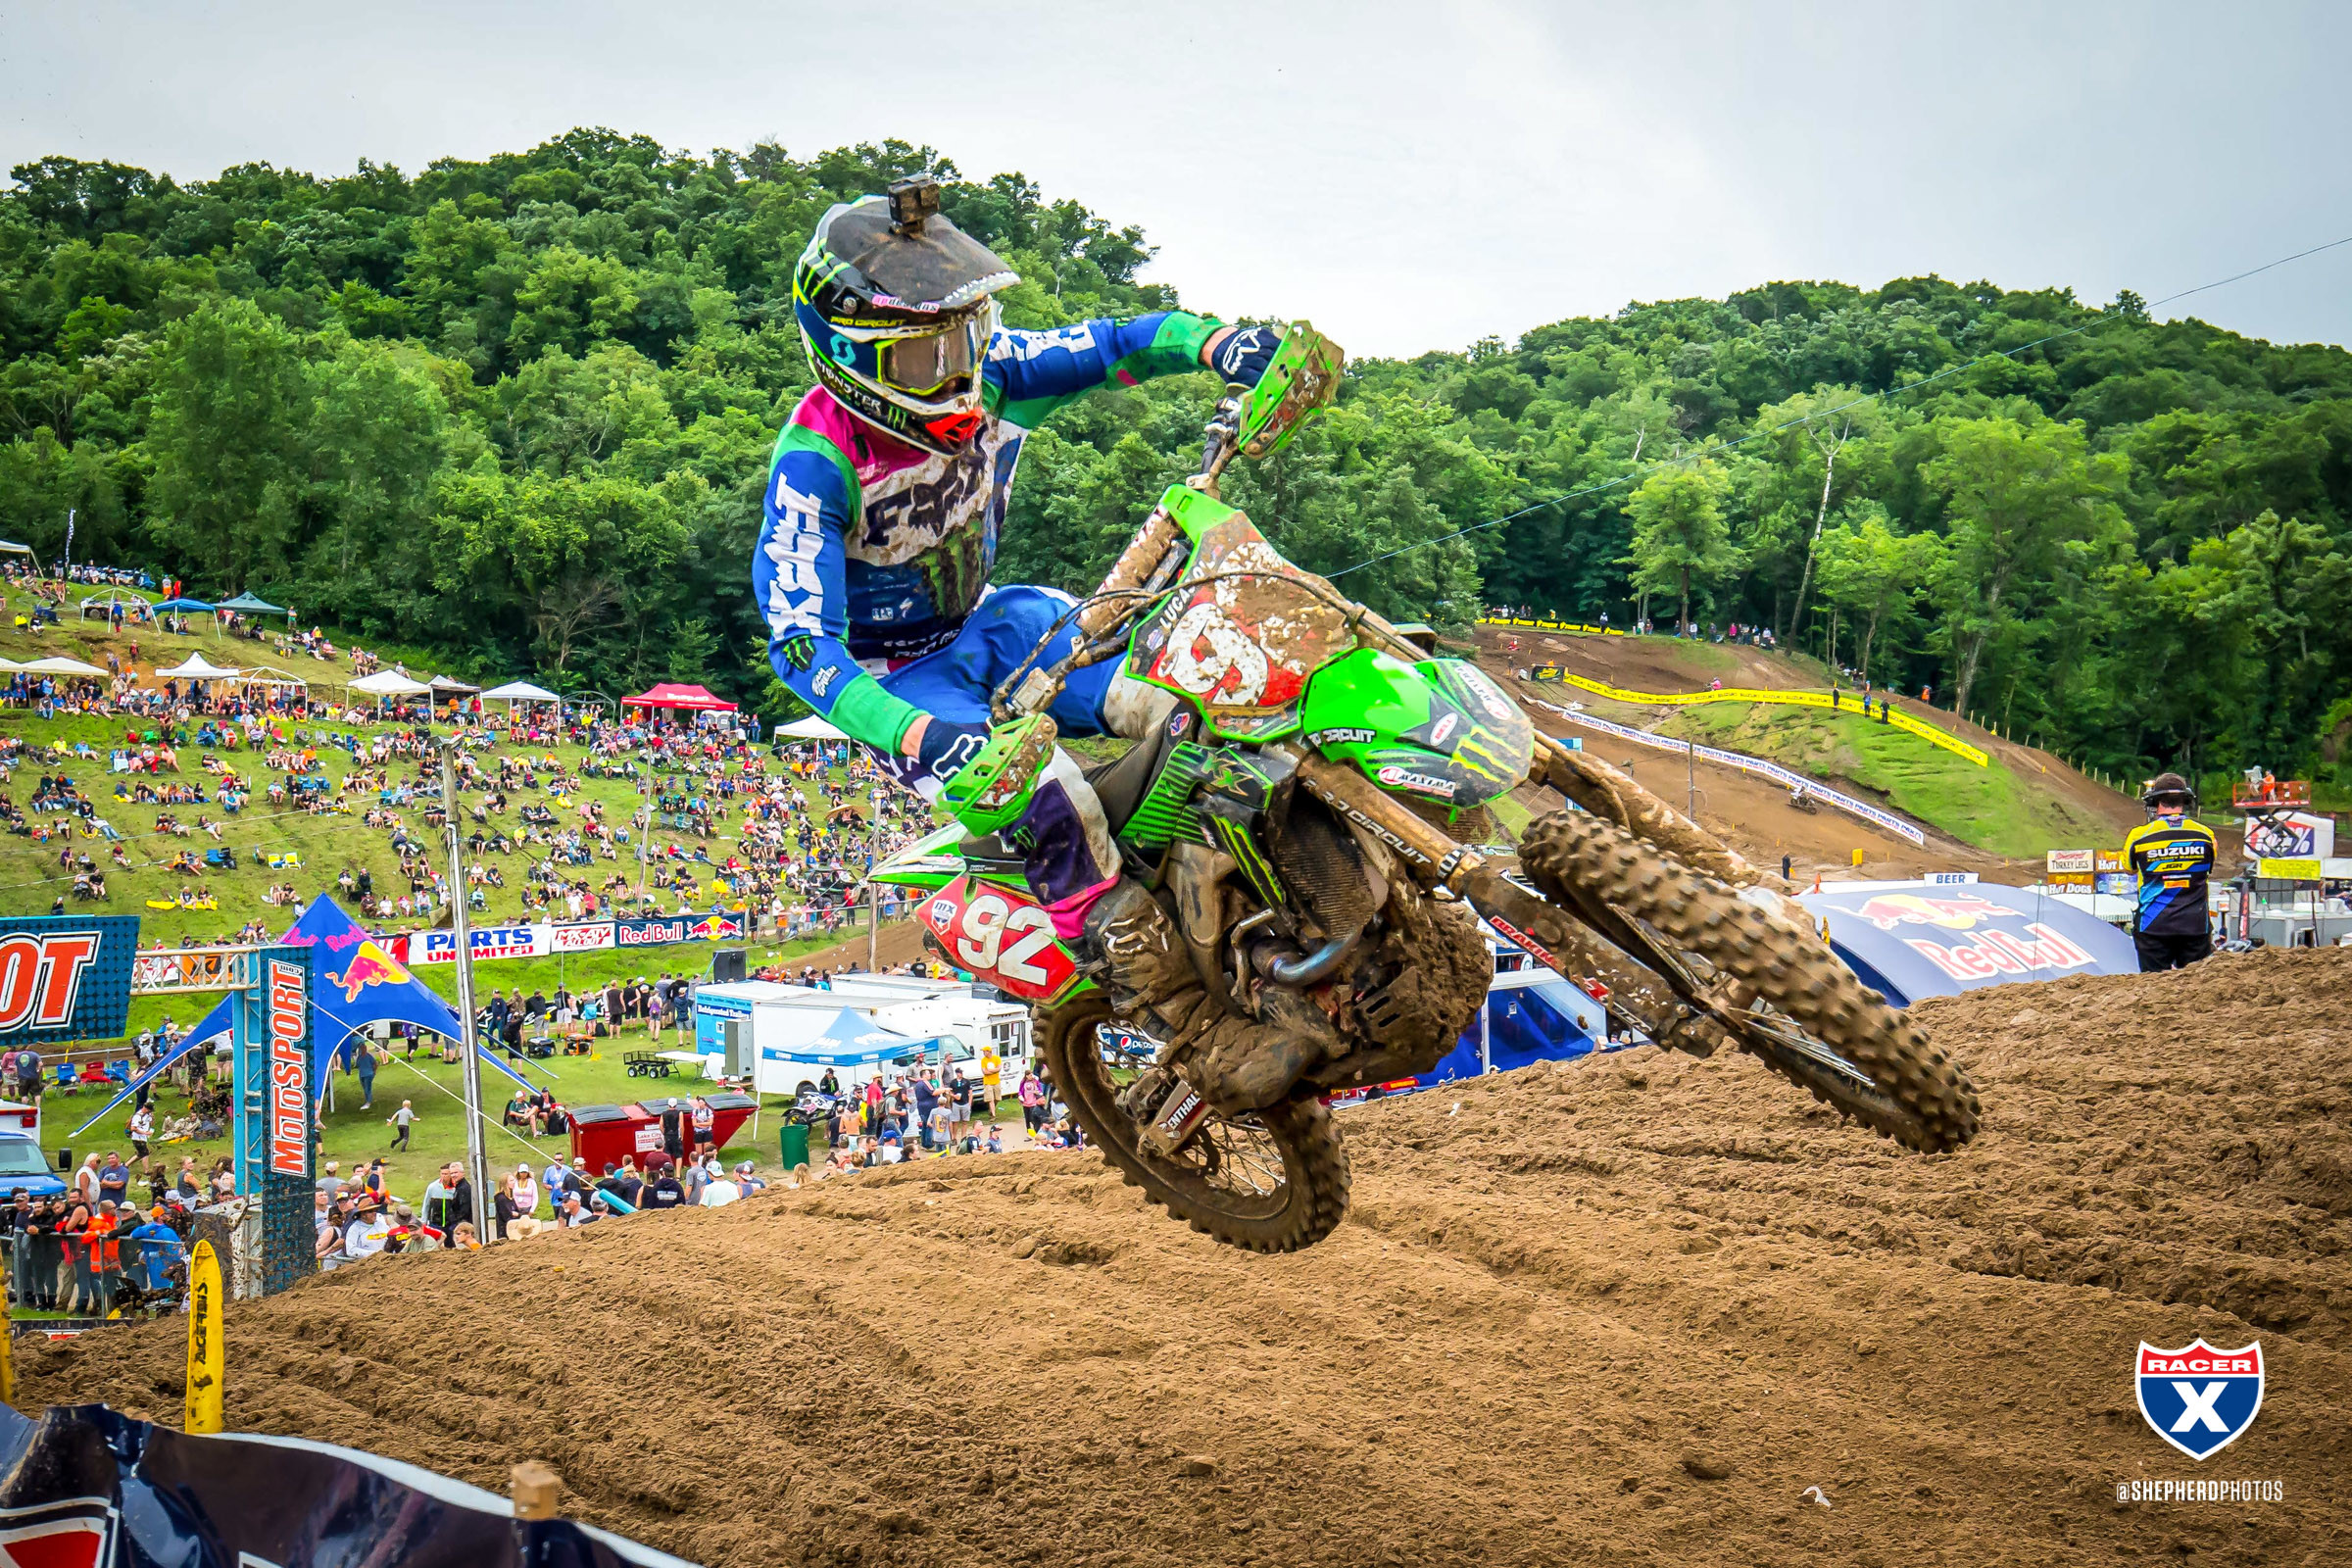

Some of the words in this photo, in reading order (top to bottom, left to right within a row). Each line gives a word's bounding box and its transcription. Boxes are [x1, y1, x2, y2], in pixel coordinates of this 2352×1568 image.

[764, 471, 825, 642] FOX
[1347, 809, 1433, 863] CIRCUIT
[2147, 846, 2204, 858] SUZUKI
[2052, 859, 2075, 869] TURKEY
[1936, 874, 1966, 884] BEER
[2049, 884, 2065, 894] HOT
[2066, 883, 2092, 894] DOGS
[956, 894, 1058, 986] 92
[427, 945, 533, 961] UNMITED
